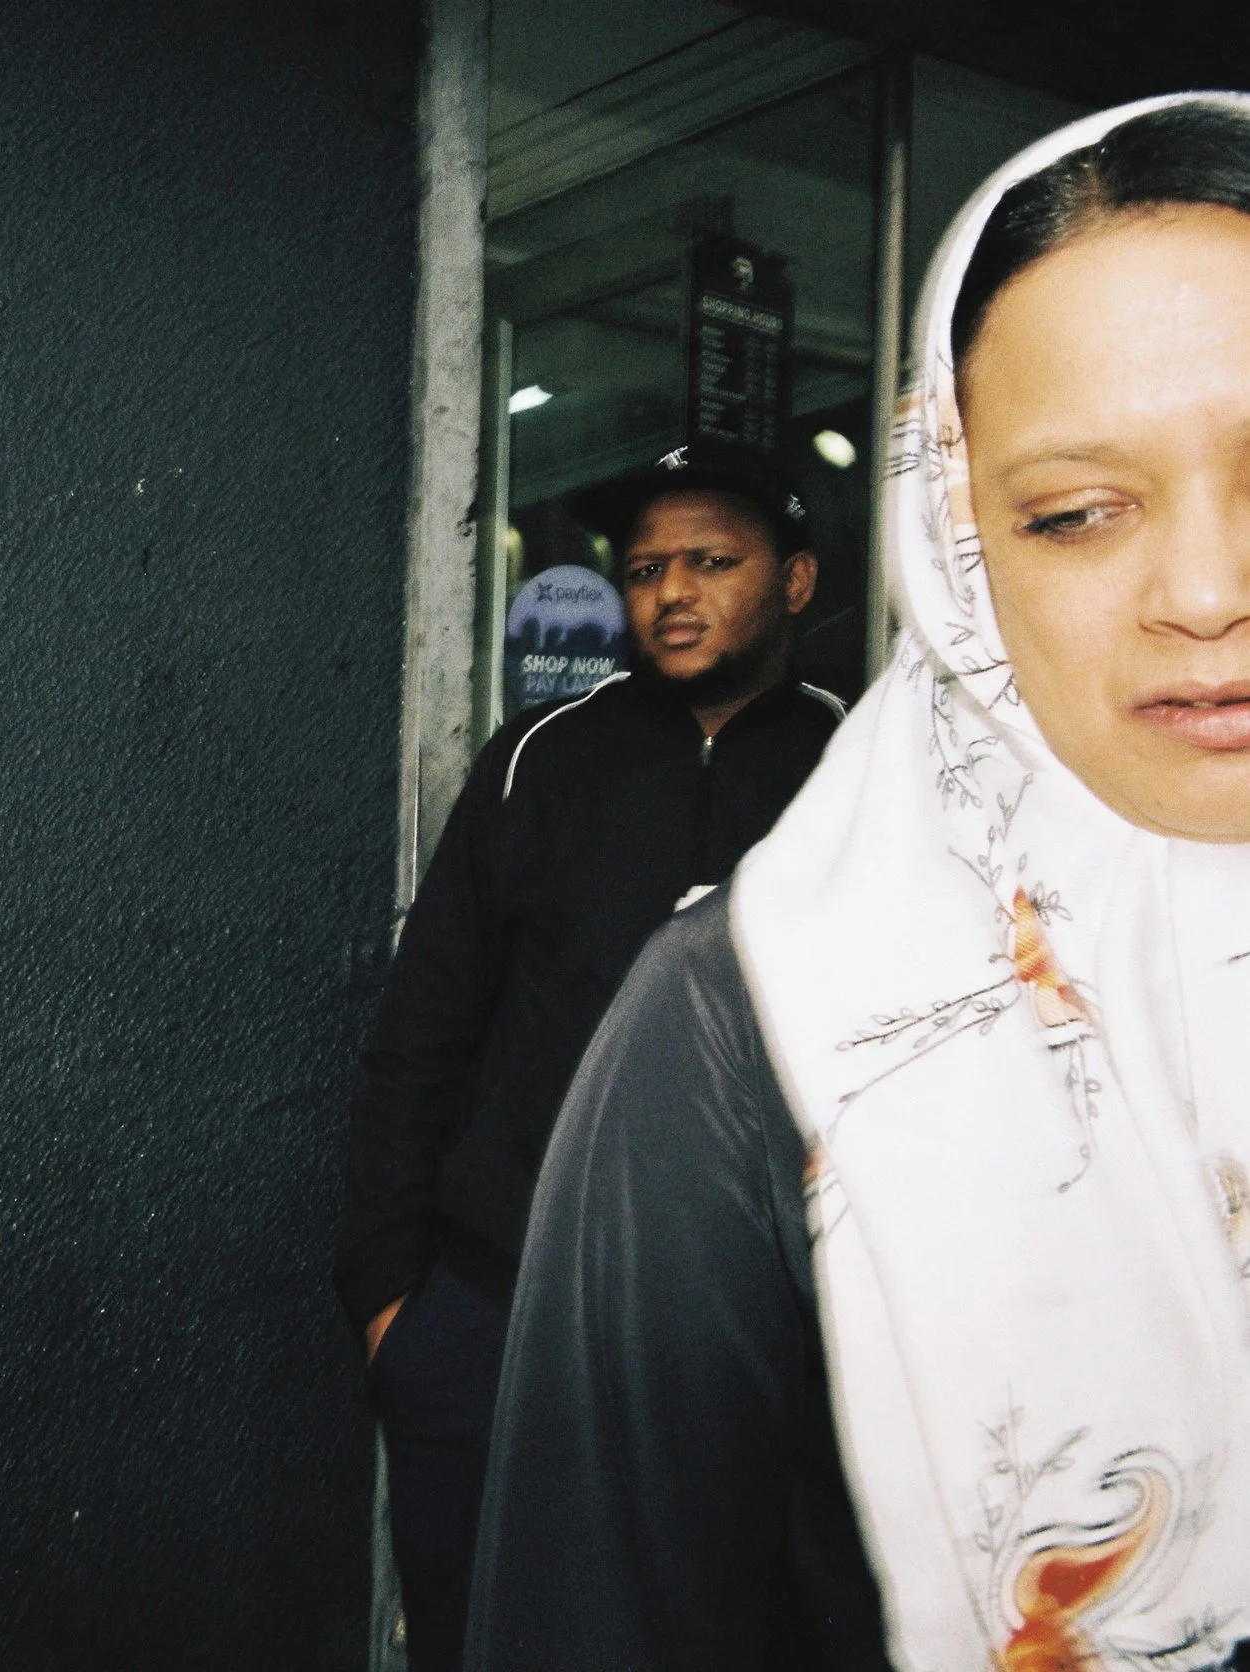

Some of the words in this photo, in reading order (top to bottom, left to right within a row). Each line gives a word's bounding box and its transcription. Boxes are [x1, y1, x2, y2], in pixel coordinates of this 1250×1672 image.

[556, 585, 603, 604] payflex
[522, 654, 569, 673] SHOP
[525, 674, 558, 692] PAY
